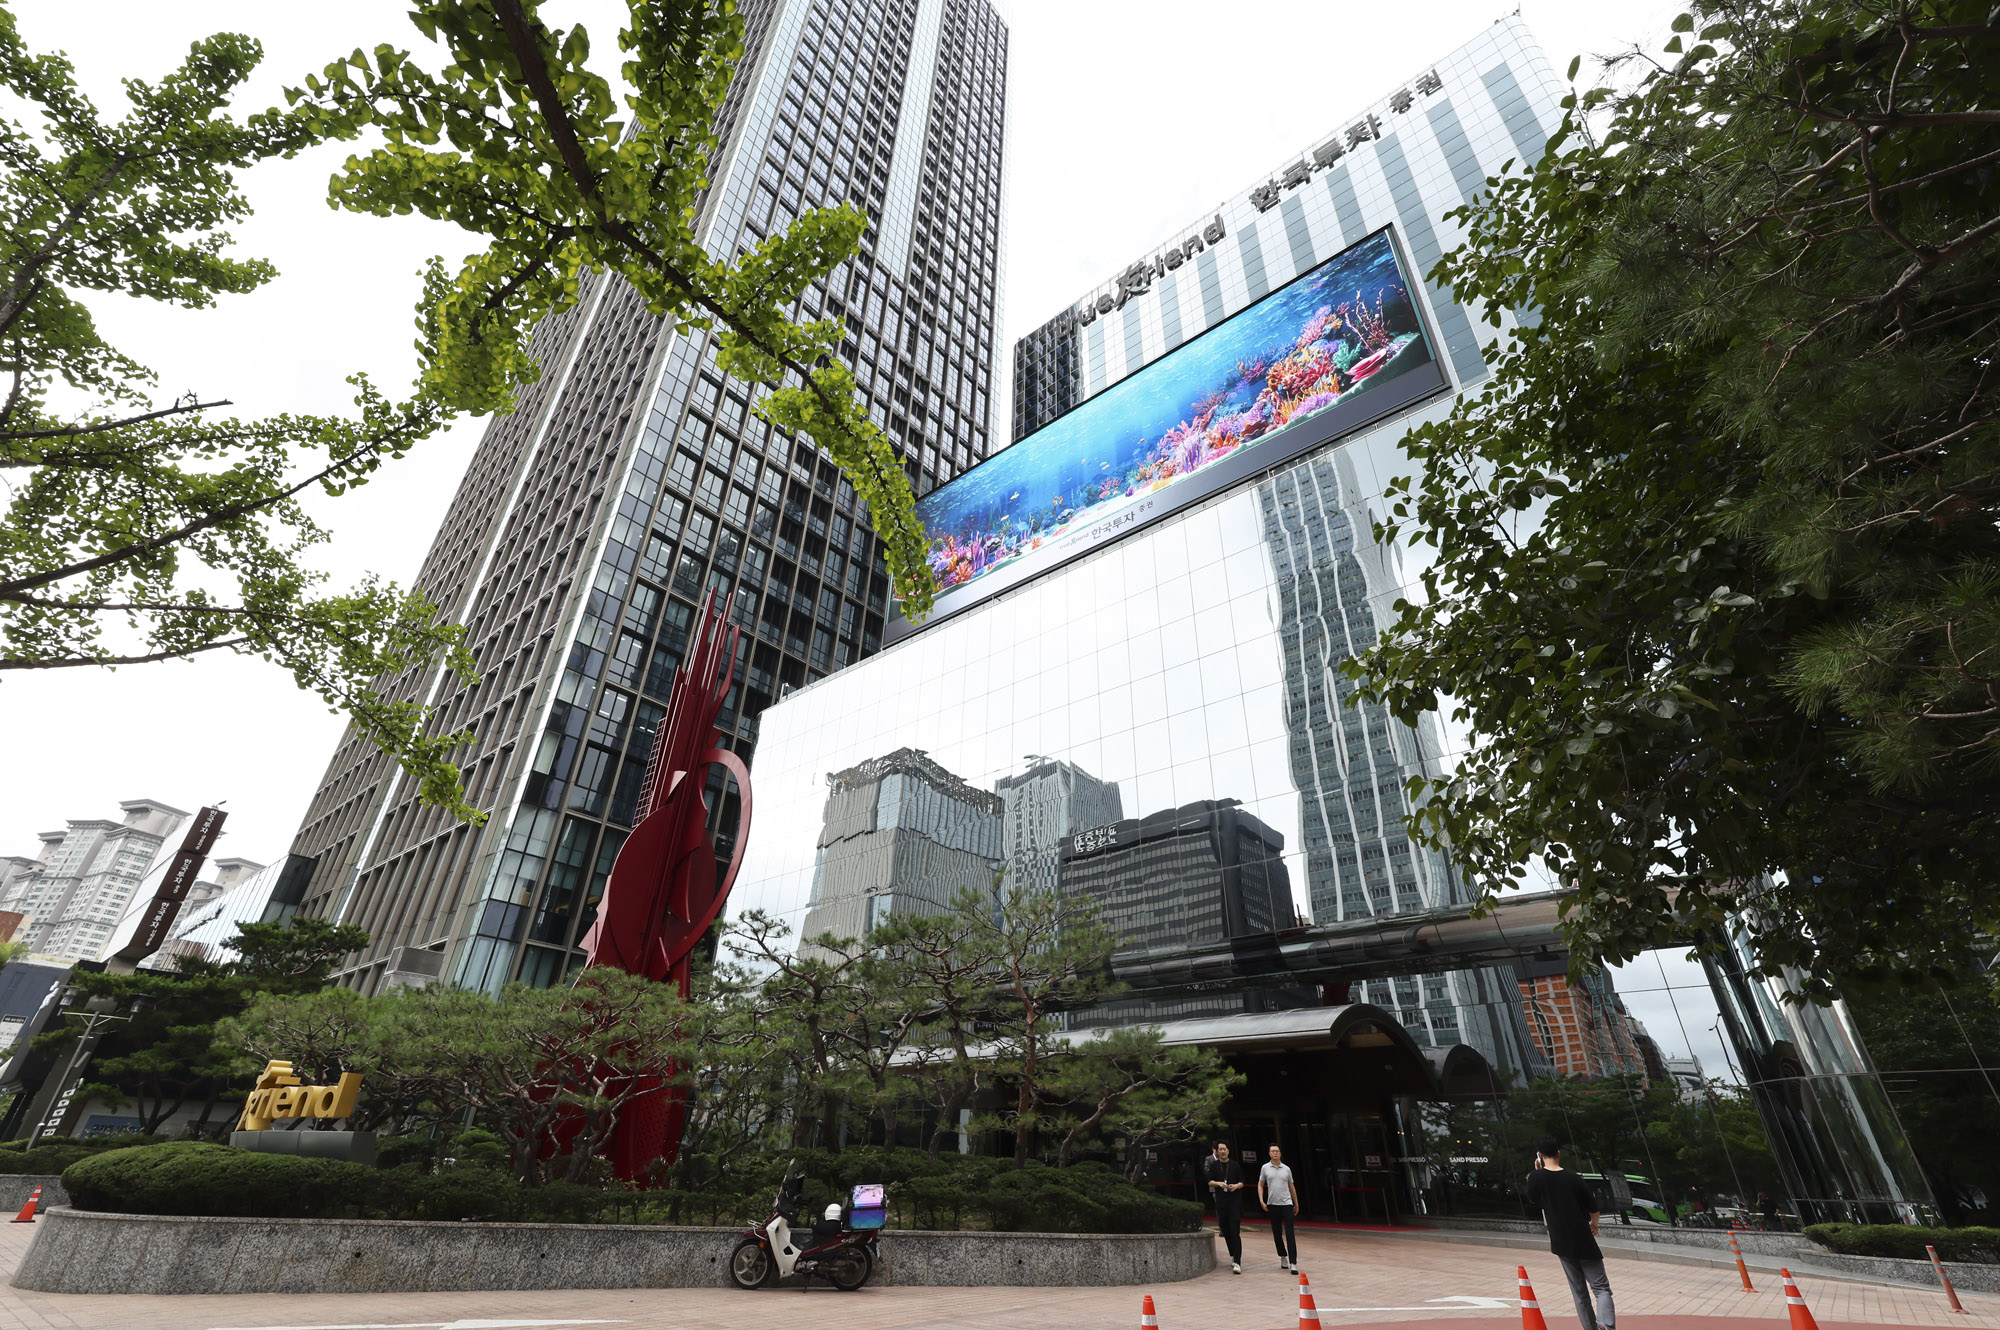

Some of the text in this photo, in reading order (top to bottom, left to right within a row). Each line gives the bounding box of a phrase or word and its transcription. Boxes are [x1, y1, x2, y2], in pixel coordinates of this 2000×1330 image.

[1249, 113, 1383, 214] 한국투자
[1390, 69, 1443, 114] 증권
[1091, 511, 1135, 539] 한국투자
[1139, 500, 1153, 512] 증권
[200, 810, 218, 835] 한국투자
[173, 858, 192, 885] 한국투자
[150, 902, 170, 929] 한국투자
